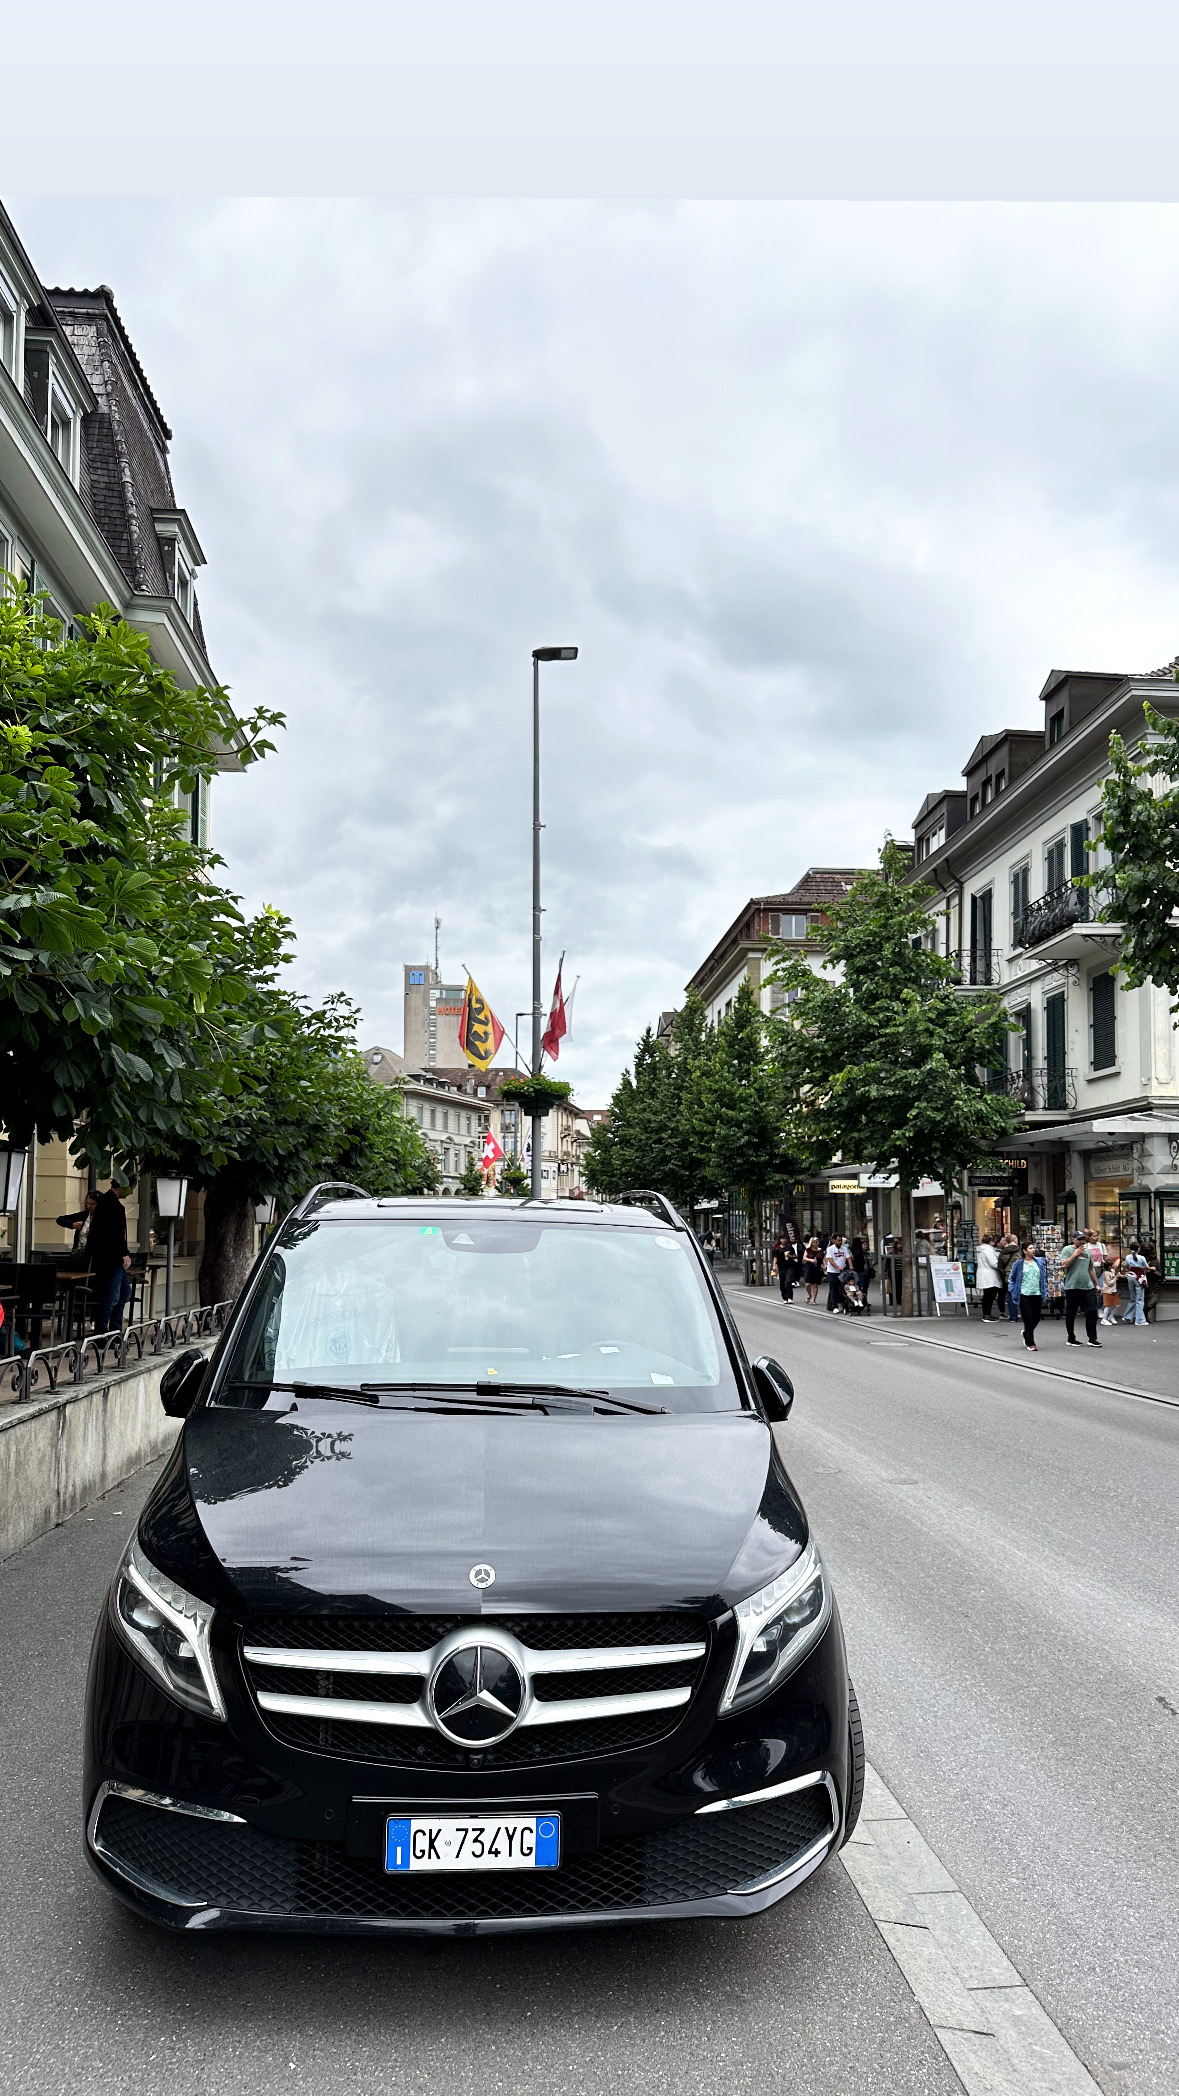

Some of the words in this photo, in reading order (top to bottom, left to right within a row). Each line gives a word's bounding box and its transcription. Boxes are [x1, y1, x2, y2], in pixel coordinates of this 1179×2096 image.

[831, 1183, 866, 1191] patagon
[412, 1828, 442, 1860] GK
[454, 1826, 534, 1859] 734YG
